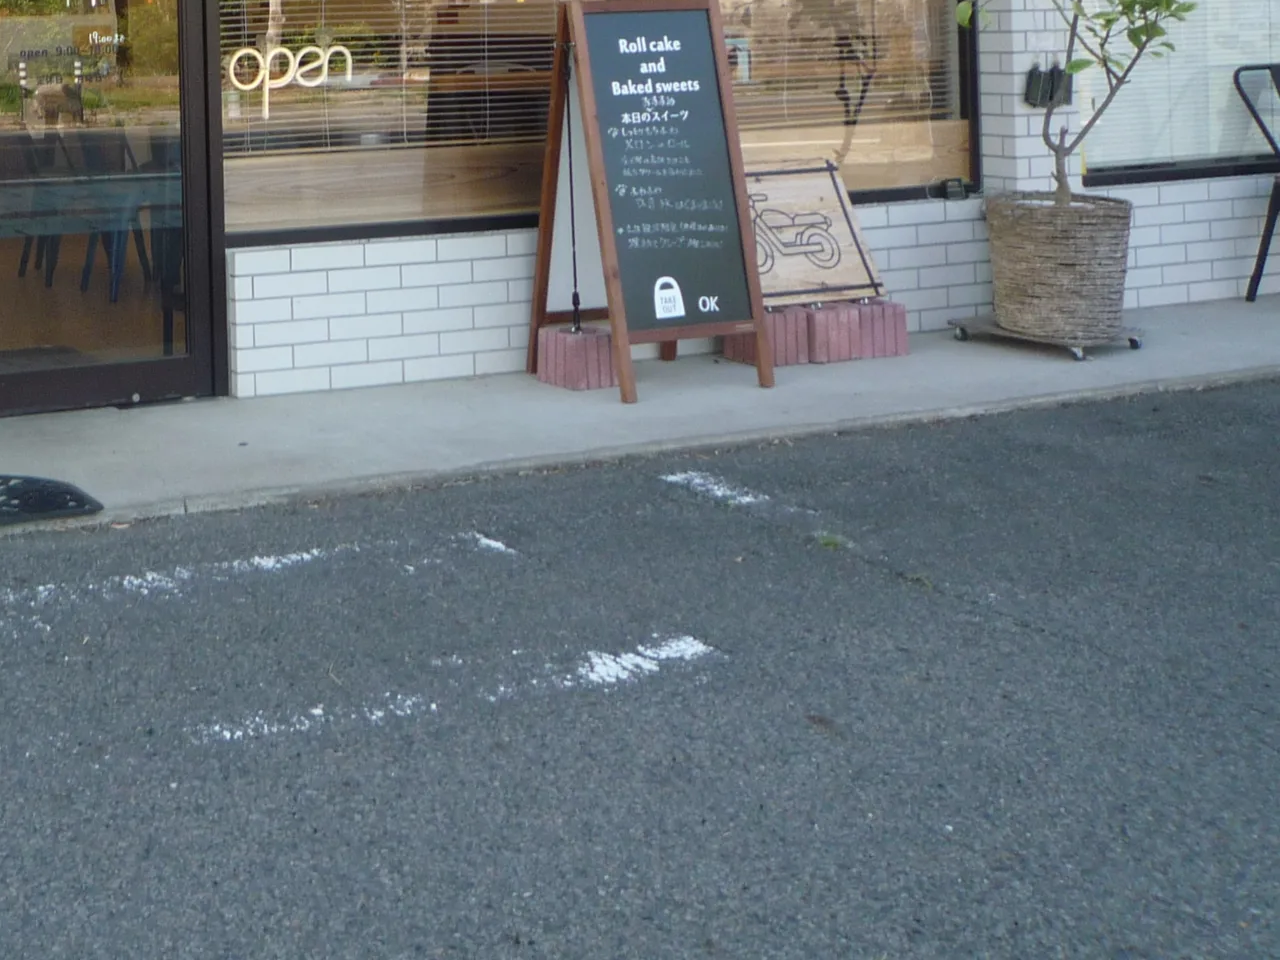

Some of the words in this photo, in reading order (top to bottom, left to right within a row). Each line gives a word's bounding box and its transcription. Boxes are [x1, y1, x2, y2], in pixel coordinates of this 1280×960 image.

[619, 37, 647, 54] Roll
[649, 36, 682, 52] cake
[19, 48, 49, 61] open
[639, 57, 666, 74] and
[229, 44, 354, 120] open
[611, 79, 654, 96] Baked
[655, 77, 700, 94] sweets
[621, 109, 689, 124] 本日のスイーツ
[697, 295, 721, 313] OK
